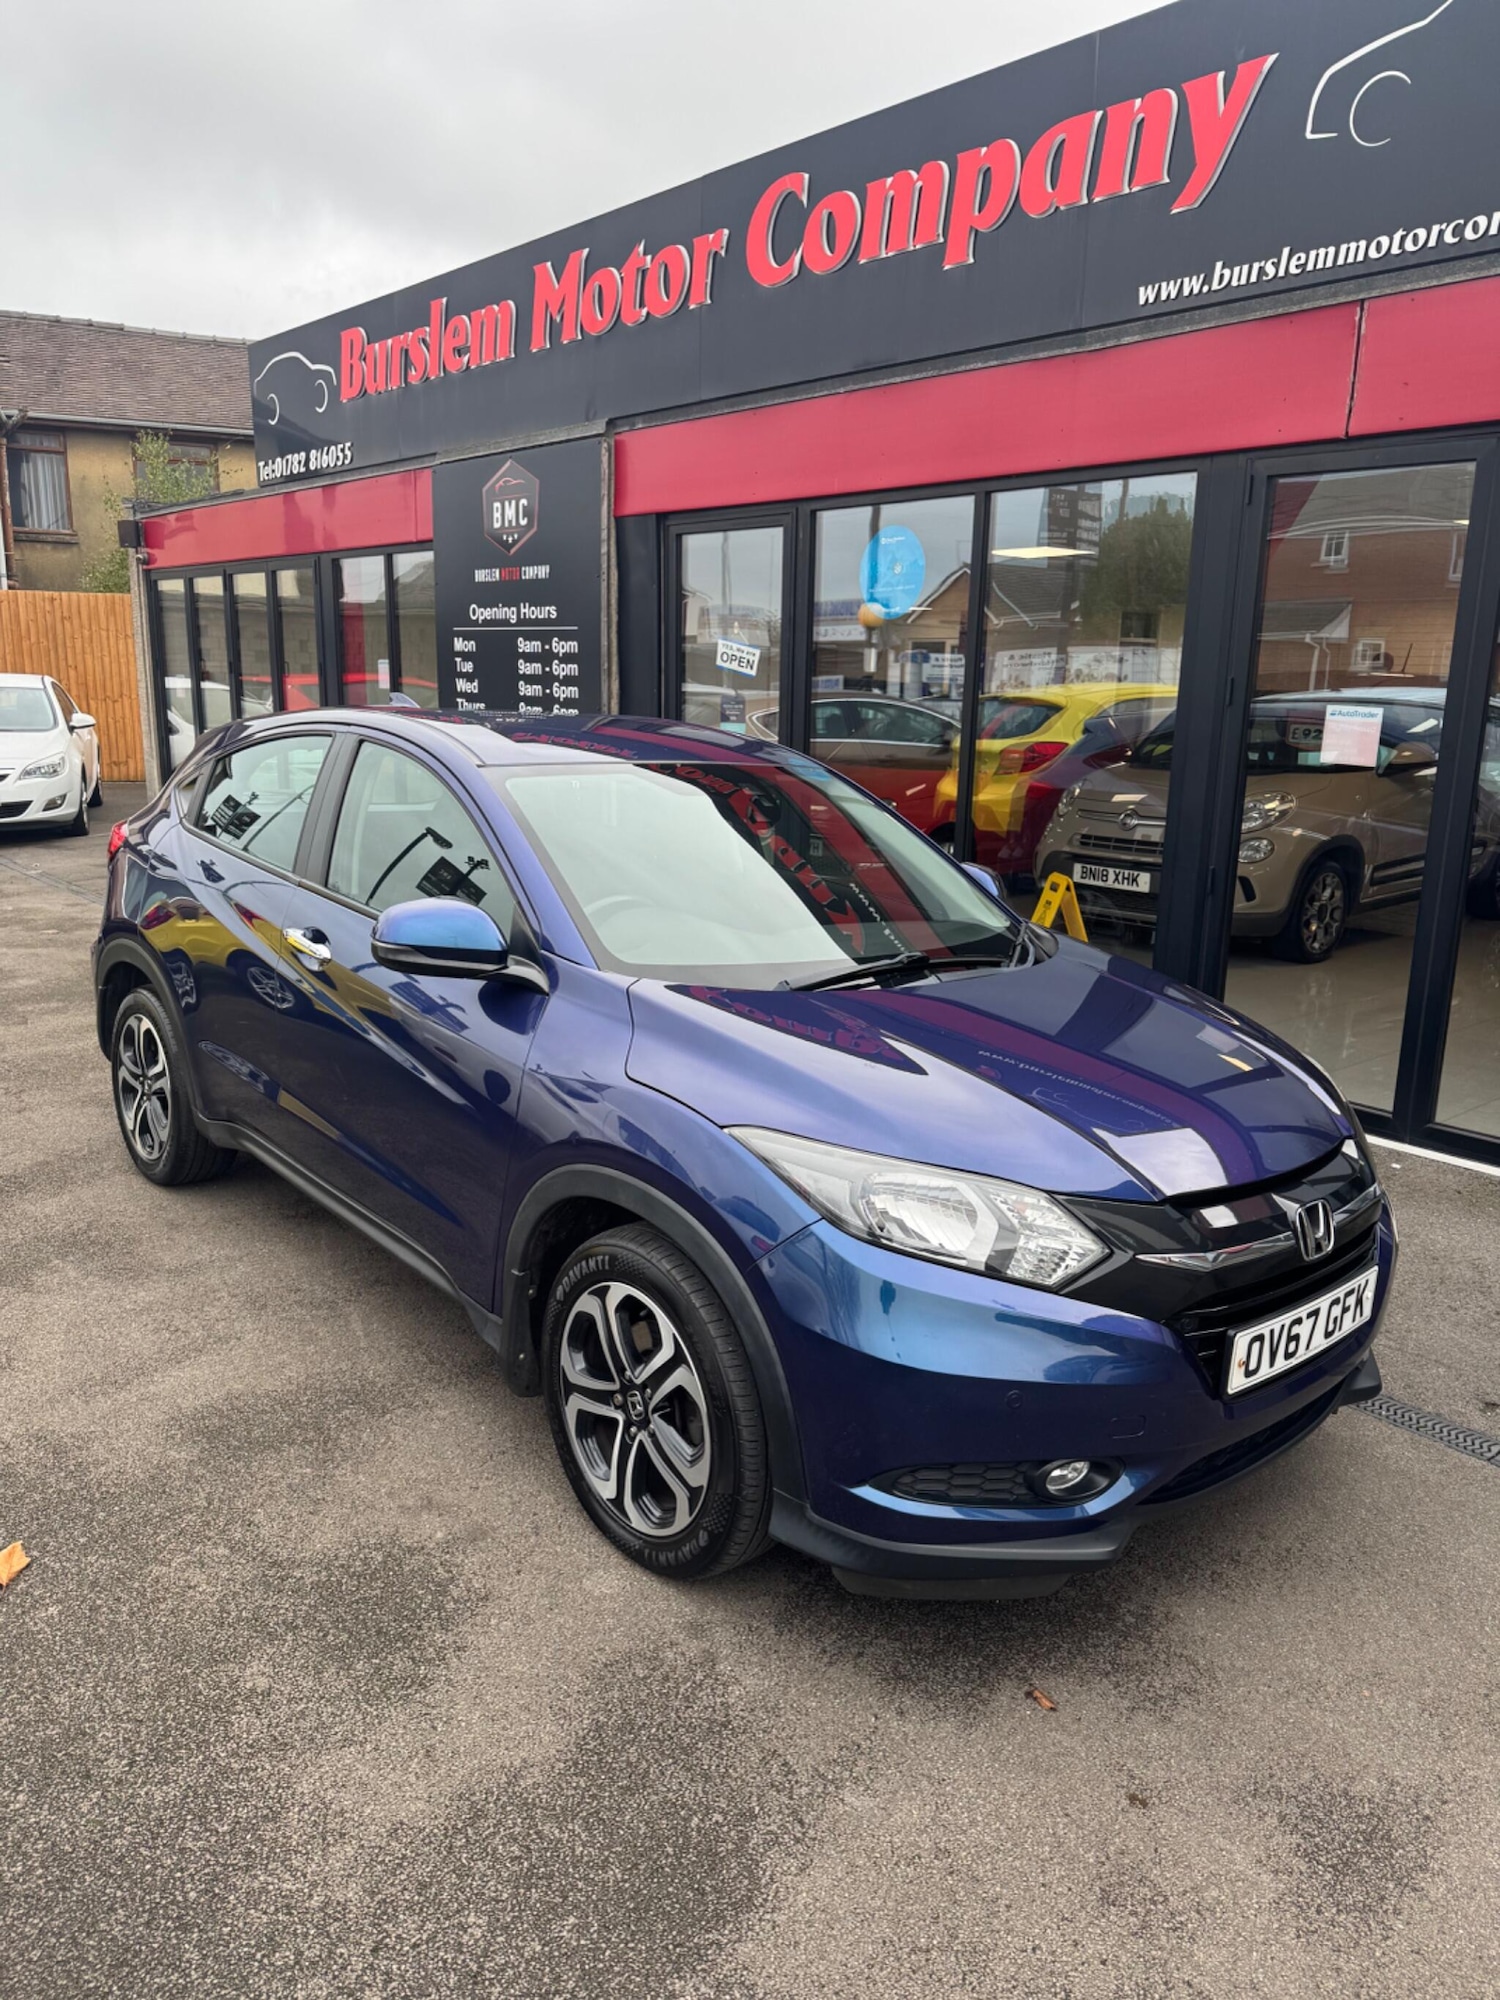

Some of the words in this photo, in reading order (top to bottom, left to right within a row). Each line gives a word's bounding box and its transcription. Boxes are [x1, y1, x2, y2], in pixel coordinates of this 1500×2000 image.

[339, 297, 517, 403] Burslem
[529, 228, 729, 352] Motor
[745, 52, 1279, 287] Company
[309, 441, 353, 471] 816055
[493, 498, 528, 529] BMC
[501, 566, 521, 581] MOTOR
[521, 564, 550, 580] COMPANY
[469, 603, 517, 624] Opening
[520, 602, 557, 619] Hours
[454, 637, 476, 652] Mon
[517, 637, 542, 653] 9am
[551, 637, 579, 657] 6pm
[455, 657, 474, 672] Tue
[517, 659, 542, 675] 9am
[552, 660, 579, 679] 6pm
[720, 651, 756, 670] OPEN
[455, 678, 479, 693] Wed
[518, 681, 543, 697] 9am
[552, 682, 579, 701] 6pm
[1337, 710, 1379, 719] AutoTrader
[1081, 865, 1109, 882] BN18
[1112, 869, 1141, 888] XHK
[562, 1255, 609, 1293] DAVANTI
[1244, 1307, 1321, 1379] OV67
[1323, 1278, 1369, 1341] GFK
